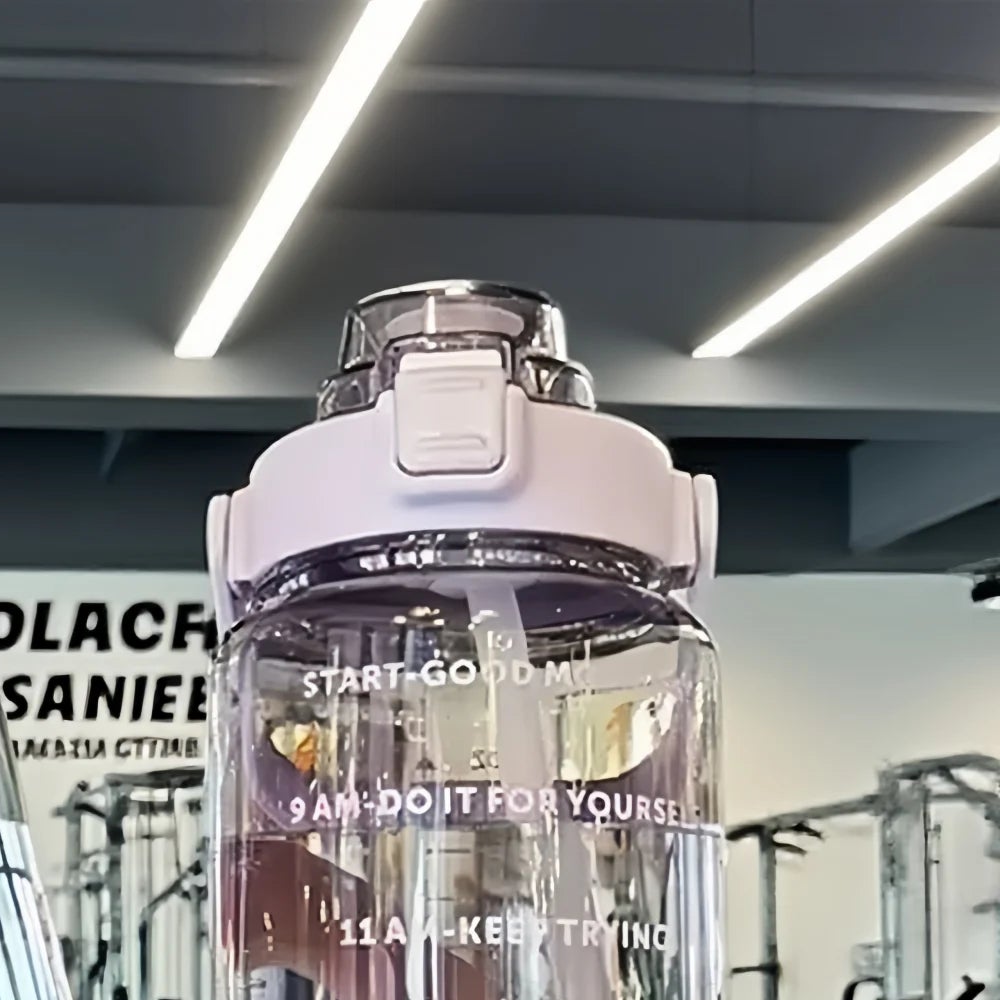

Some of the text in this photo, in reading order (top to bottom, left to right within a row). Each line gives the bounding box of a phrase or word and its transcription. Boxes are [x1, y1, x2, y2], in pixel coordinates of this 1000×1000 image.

[290, 801, 305, 824] 9
[444, 787, 478, 814] IT
[488, 788, 557, 815] FOR
[339, 919, 377, 946] 11
